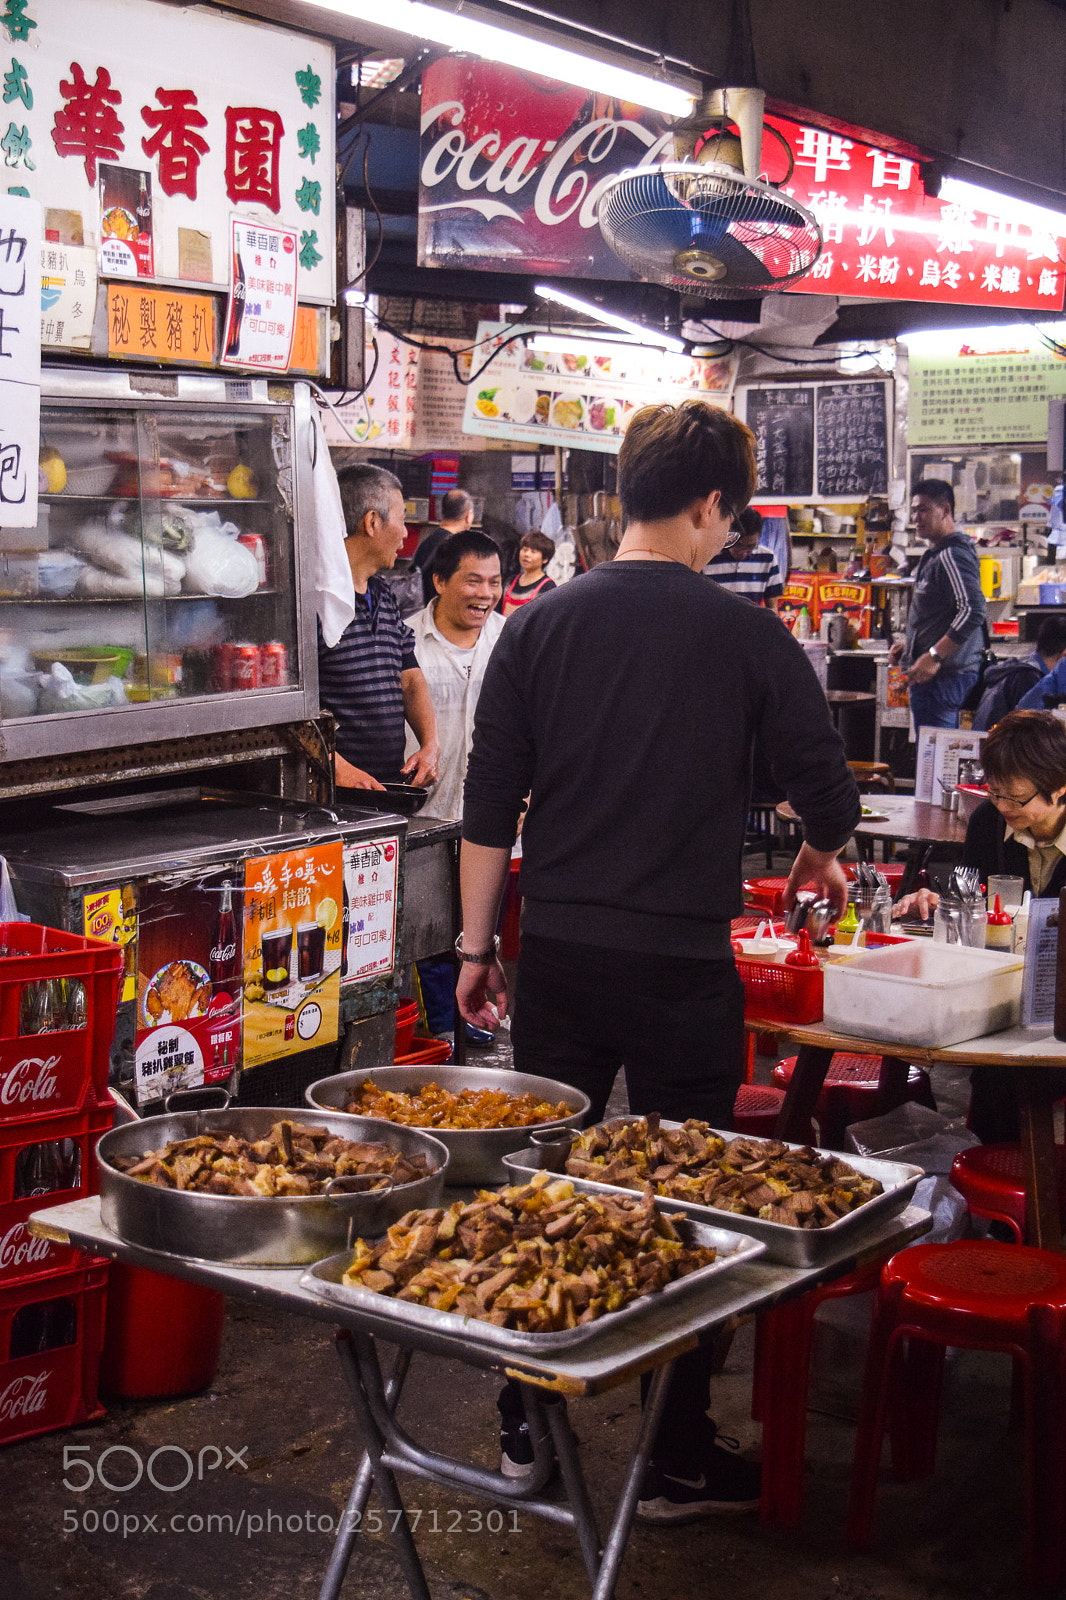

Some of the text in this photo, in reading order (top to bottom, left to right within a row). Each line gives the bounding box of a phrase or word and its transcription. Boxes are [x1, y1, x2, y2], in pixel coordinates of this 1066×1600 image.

[0, 0, 38, 198] 各式飲
[51, 62, 285, 214] 華香園
[246, 231, 279, 254] 華香園
[112, 294, 210, 353] 秘製豬扒
[350, 849, 380, 871] 華香園
[254, 856, 336, 895] 暖手暖心
[358, 871, 378, 885] 推介
[283, 886, 312, 911] 特飲
[92, 914, 109, 932] 100
[210, 943, 236, 961] Coca-Cola
